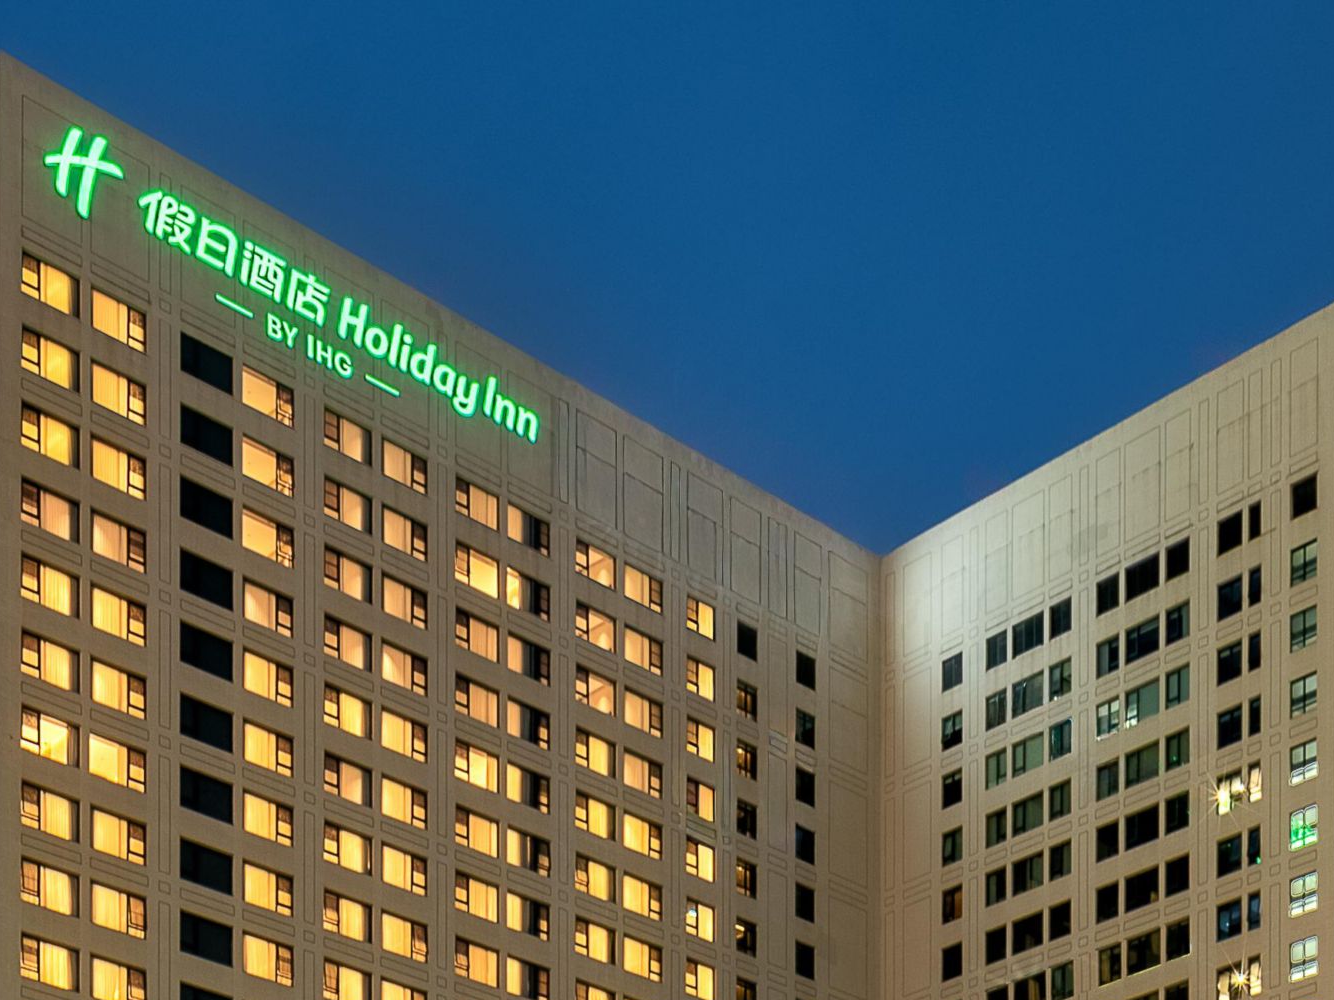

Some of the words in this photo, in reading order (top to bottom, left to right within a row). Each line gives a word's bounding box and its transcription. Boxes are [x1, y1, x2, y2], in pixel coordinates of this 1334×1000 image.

[138, 190, 332, 328] 假日酒店
[337, 296, 480, 418] Holiday
[482, 375, 539, 444] Inn
[267, 313, 299, 349] BY
[305, 333, 354, 379] IHG
